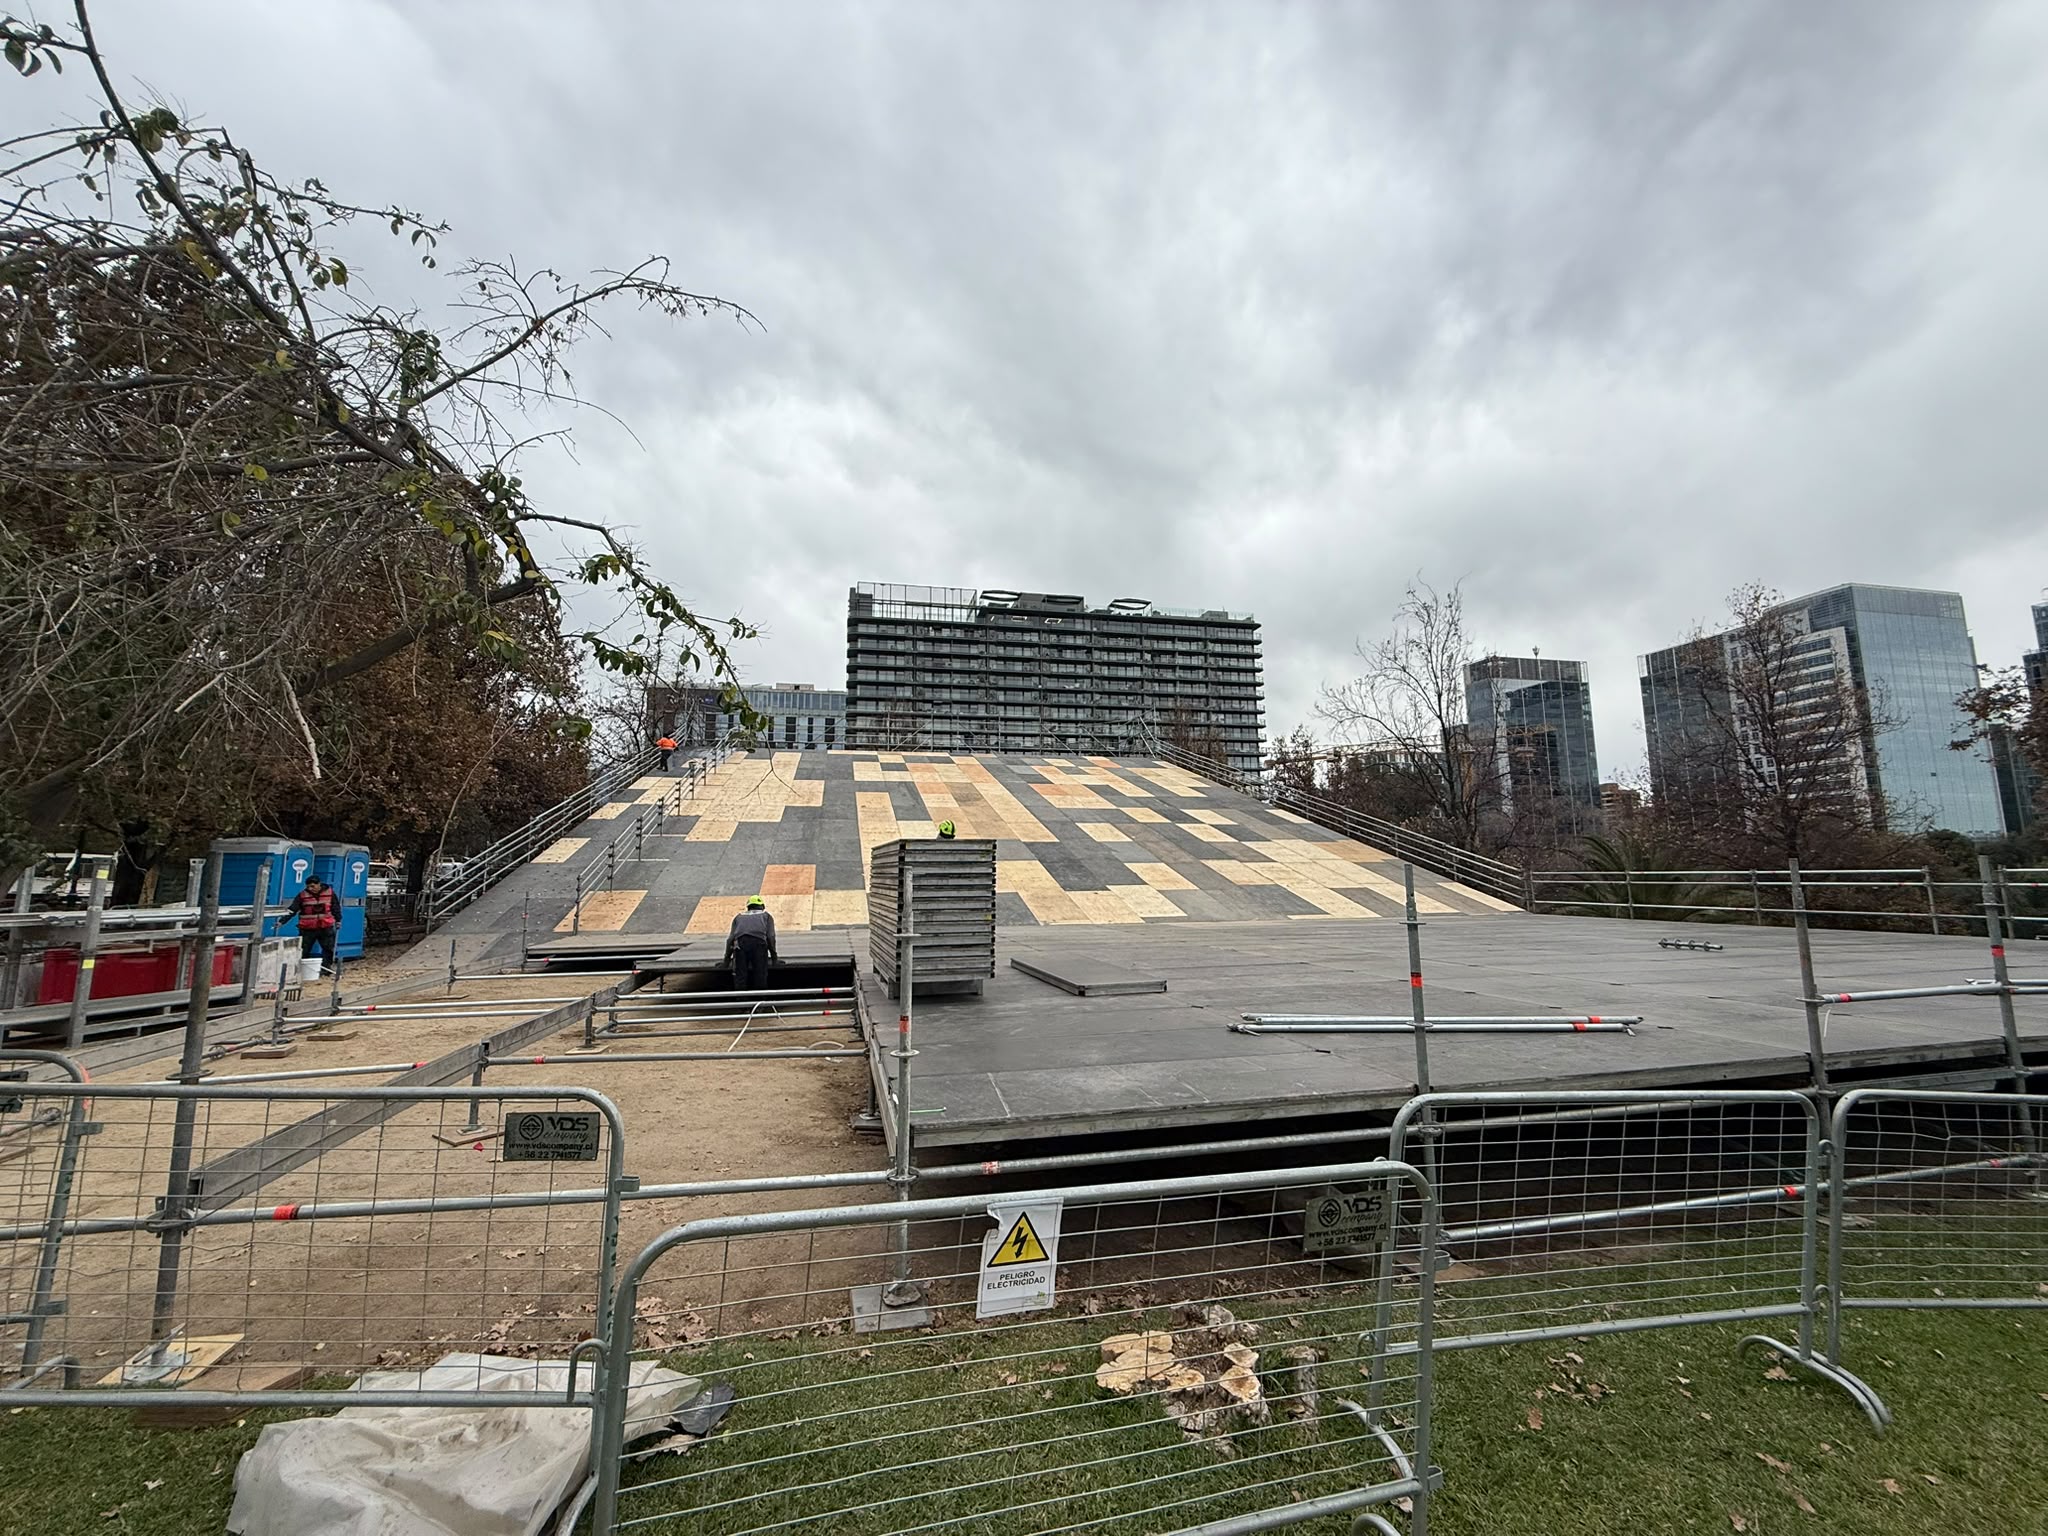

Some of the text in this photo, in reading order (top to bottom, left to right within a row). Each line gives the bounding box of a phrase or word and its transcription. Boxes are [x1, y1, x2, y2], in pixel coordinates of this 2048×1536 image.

[537, 1150, 549, 1158] 22
[999, 1270, 1036, 1281] PELIGRO
[986, 1276, 1046, 1290] ELECTRICIDAD
